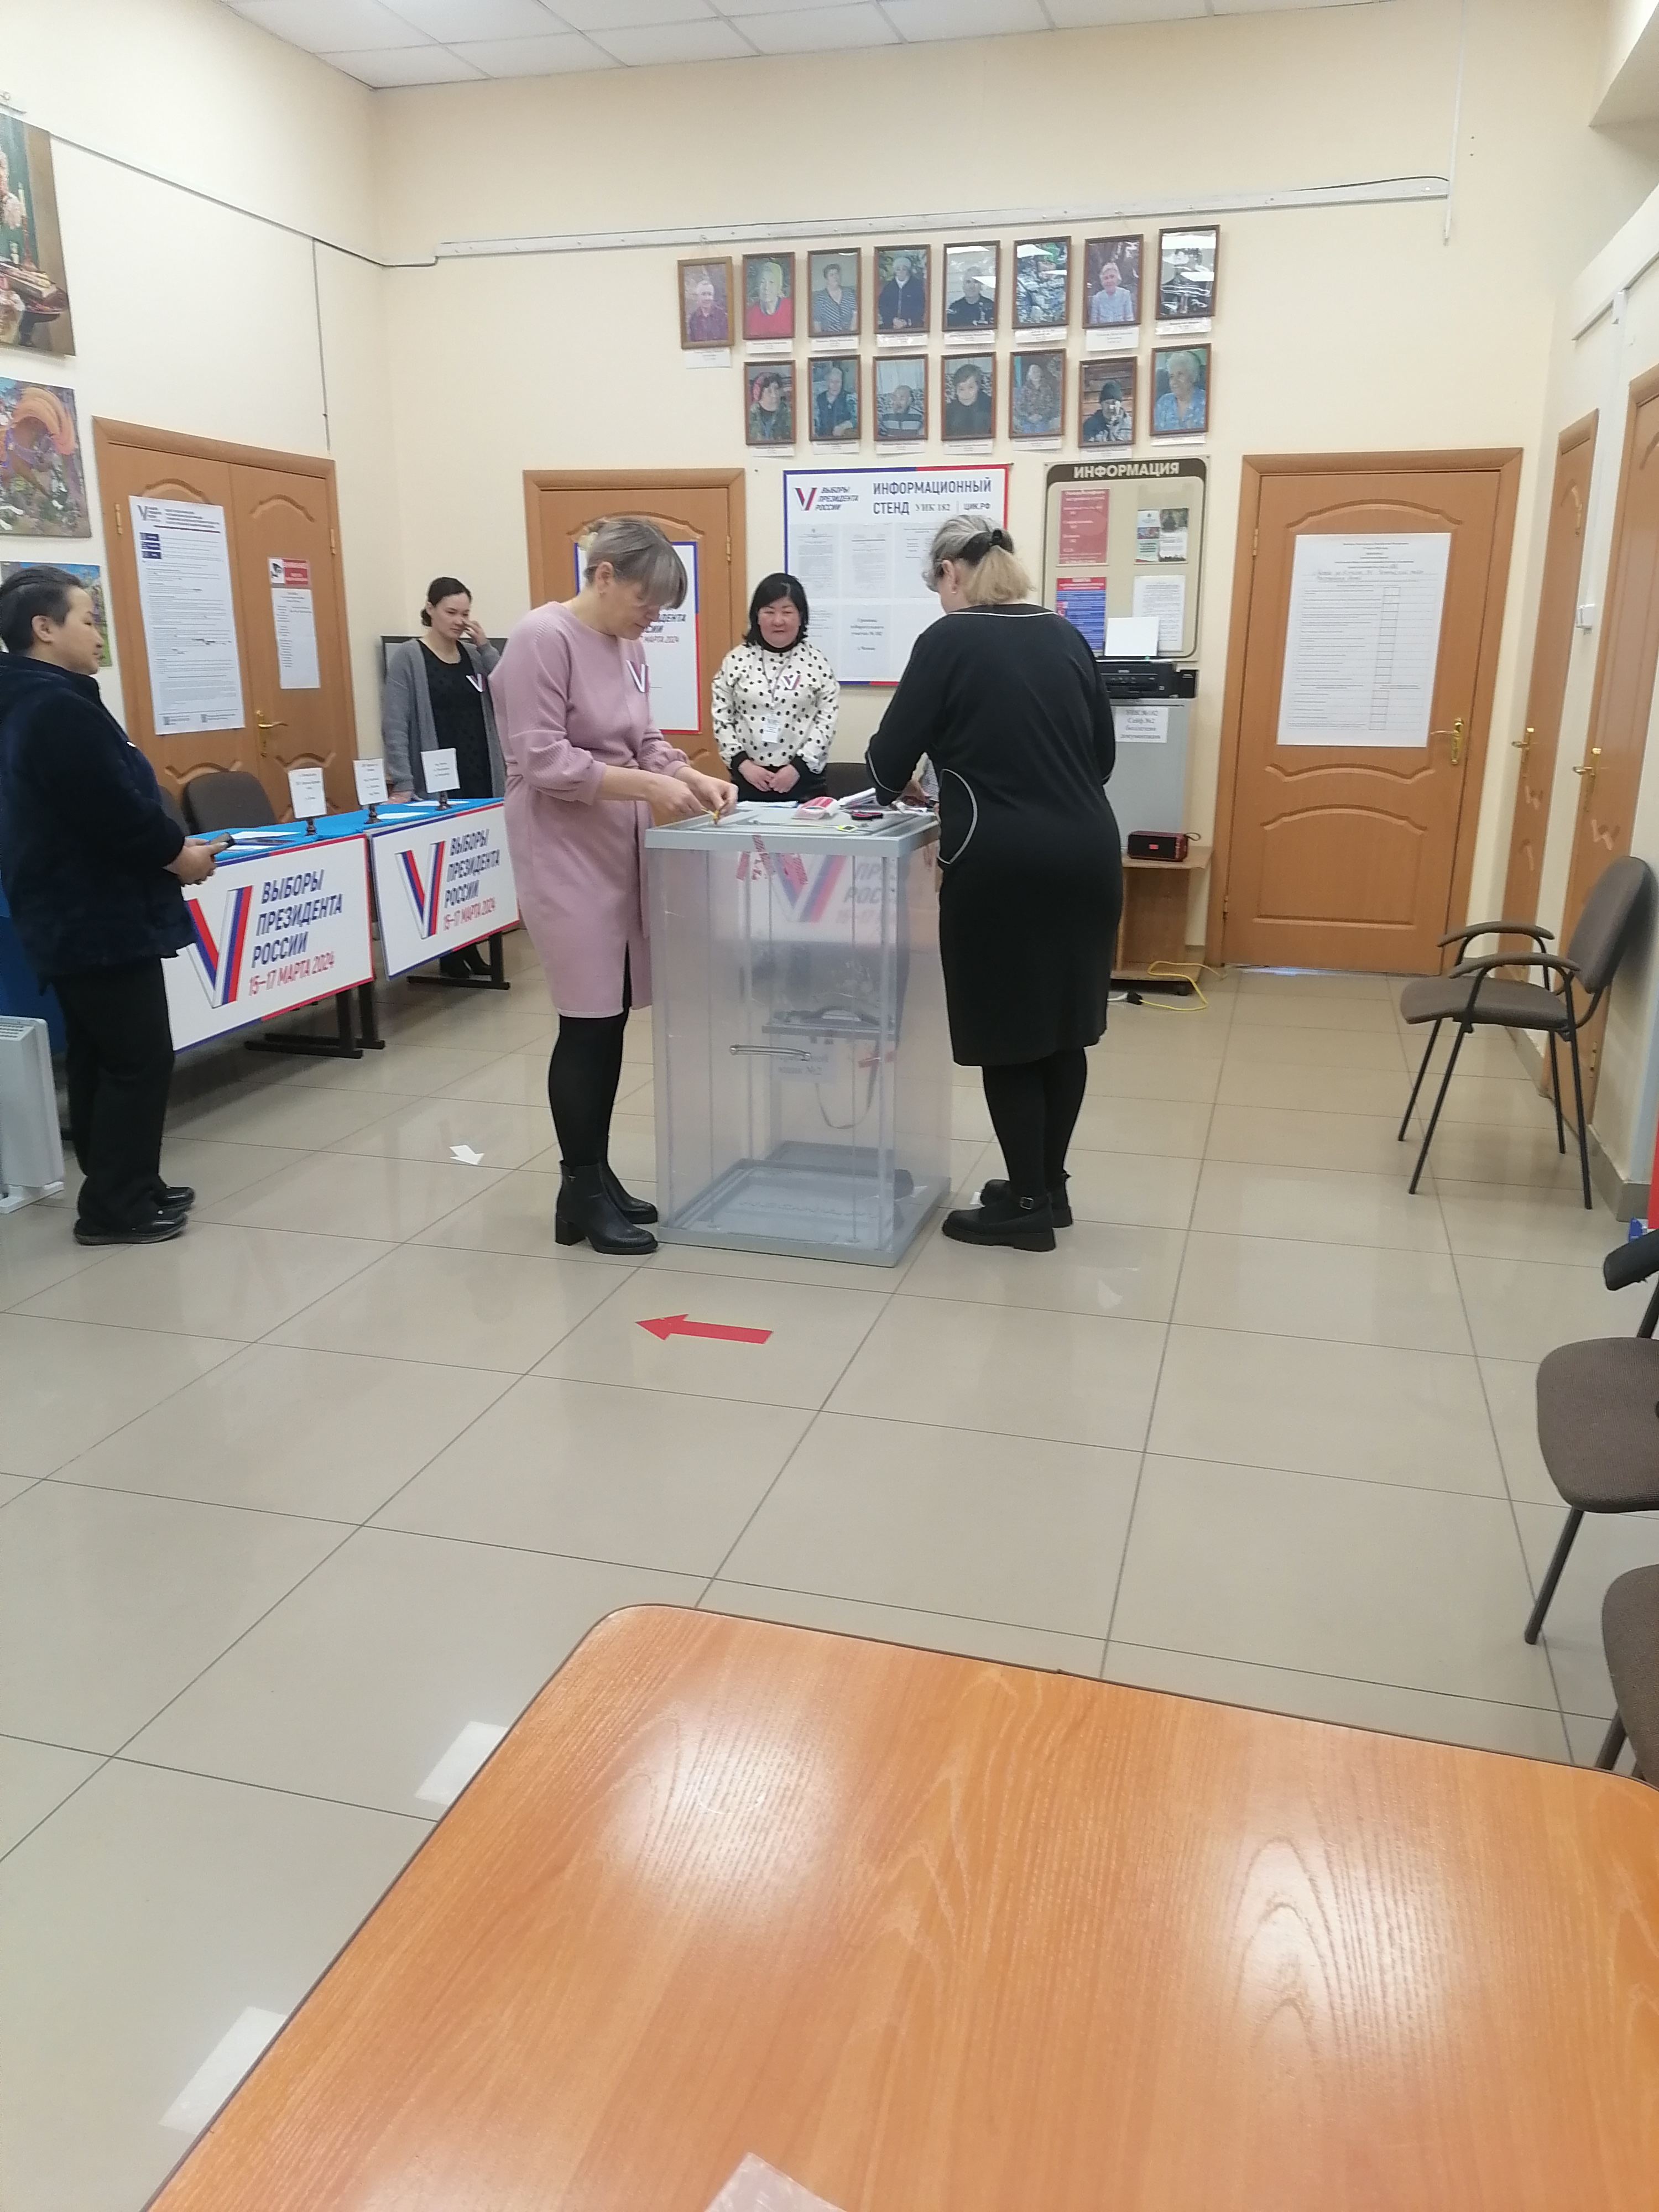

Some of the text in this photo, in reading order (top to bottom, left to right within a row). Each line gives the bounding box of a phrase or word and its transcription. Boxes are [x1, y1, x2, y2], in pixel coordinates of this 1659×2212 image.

[873, 477, 992, 495] ИНФОРМАЦИОННЫЙ
[1073, 462, 1180, 478] ИНФОРМАЦИЯ
[873, 502, 910, 515] СТЕНД
[449, 828, 490, 856] ВЫБОРЫ
[446, 849, 500, 883] ПРЕЗИДЕНТА
[261, 869, 325, 905] ВЫБОРЫ
[444, 879, 480, 909] РОССИИ
[255, 893, 343, 936] ПРЕЗИДЕНТА
[251, 931, 309, 969] РОССИИ
[277, 958, 311, 986] МАРТА
[312, 951, 335, 974] 2024
